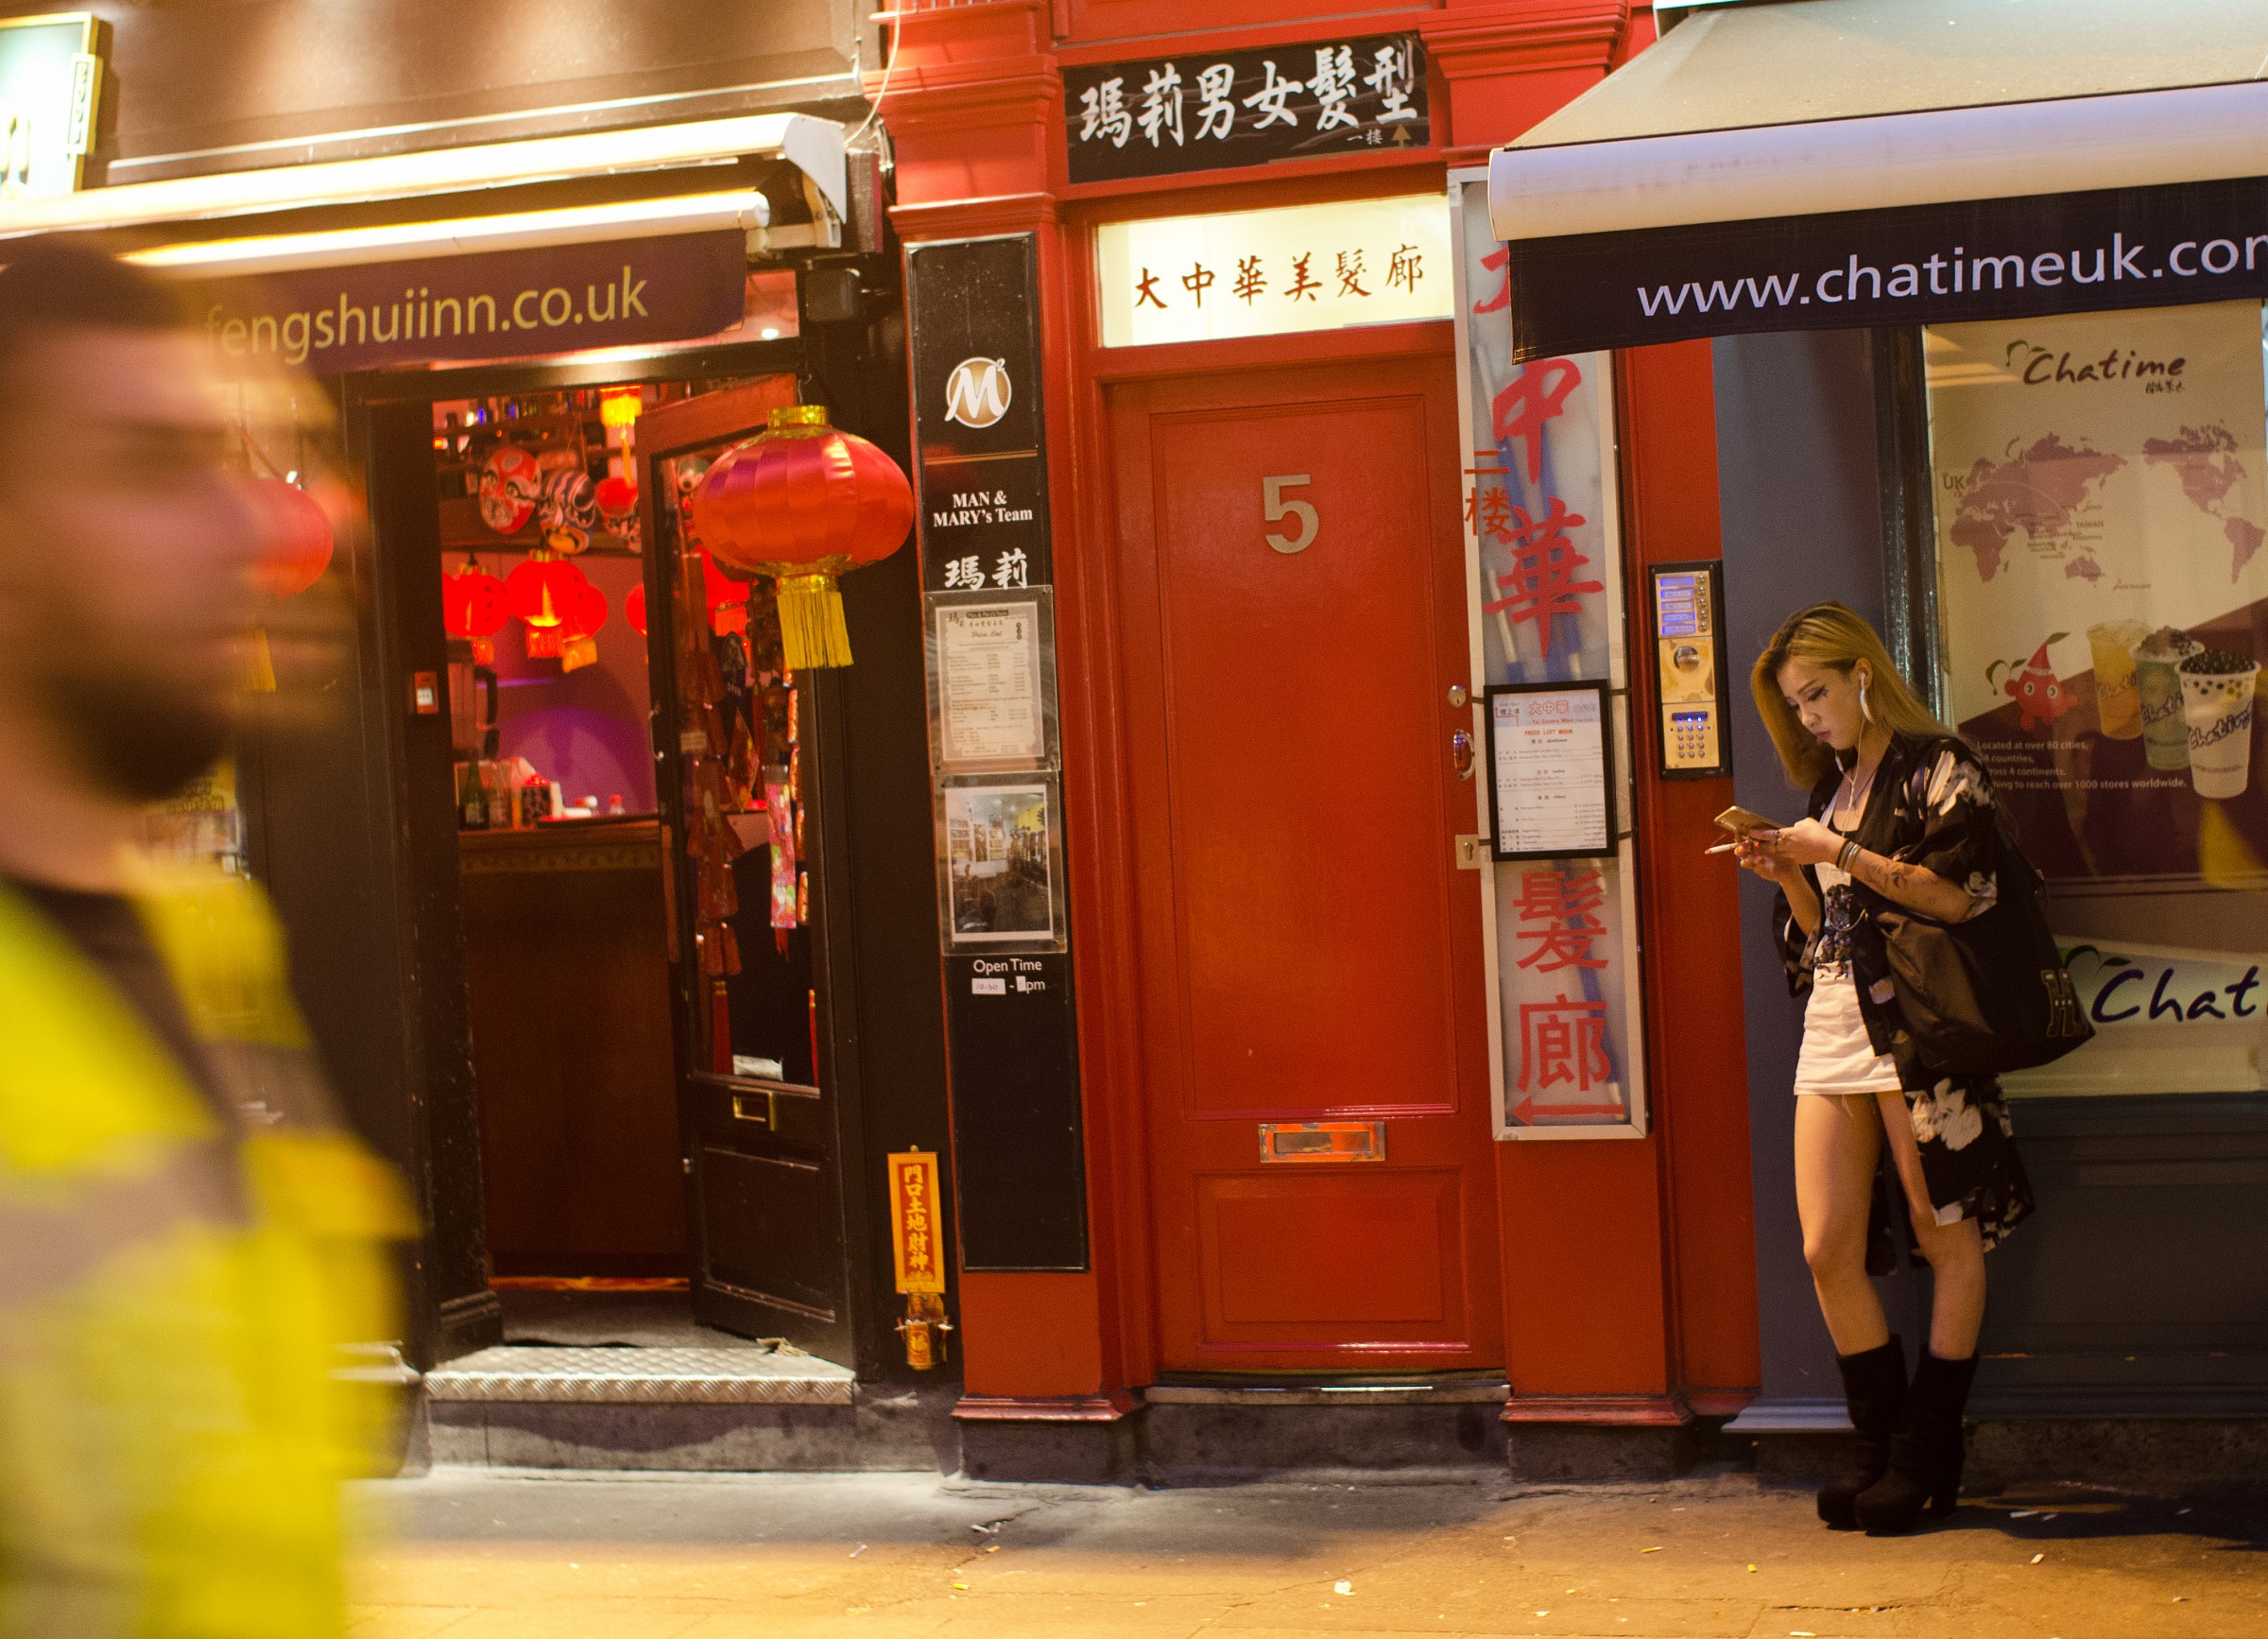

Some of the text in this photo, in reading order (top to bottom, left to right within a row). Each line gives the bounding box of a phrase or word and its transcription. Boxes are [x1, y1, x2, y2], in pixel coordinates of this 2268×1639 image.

[1080, 40, 1418, 148] 瑪莉男女髮型
[1135, 243, 1423, 309] 大中華美髮廊
[2022, 349, 2186, 385] Chatime
[1943, 474, 1965, 490] UK
[953, 490, 1007, 509] MAN &
[933, 508, 1034, 527] MARY's Team
[1263, 474, 1319, 554] 5
[945, 547, 1027, 591] 瑪莉
[1977, 741, 2012, 750] Located
[2015, 741, 2023, 750] at
[2026, 780, 2051, 788] reach
[2053, 781, 2072, 789] over
[2076, 779, 2098, 788] 1000
[2100, 780, 2129, 788] stores
[973, 958, 1043, 975] Open Time
